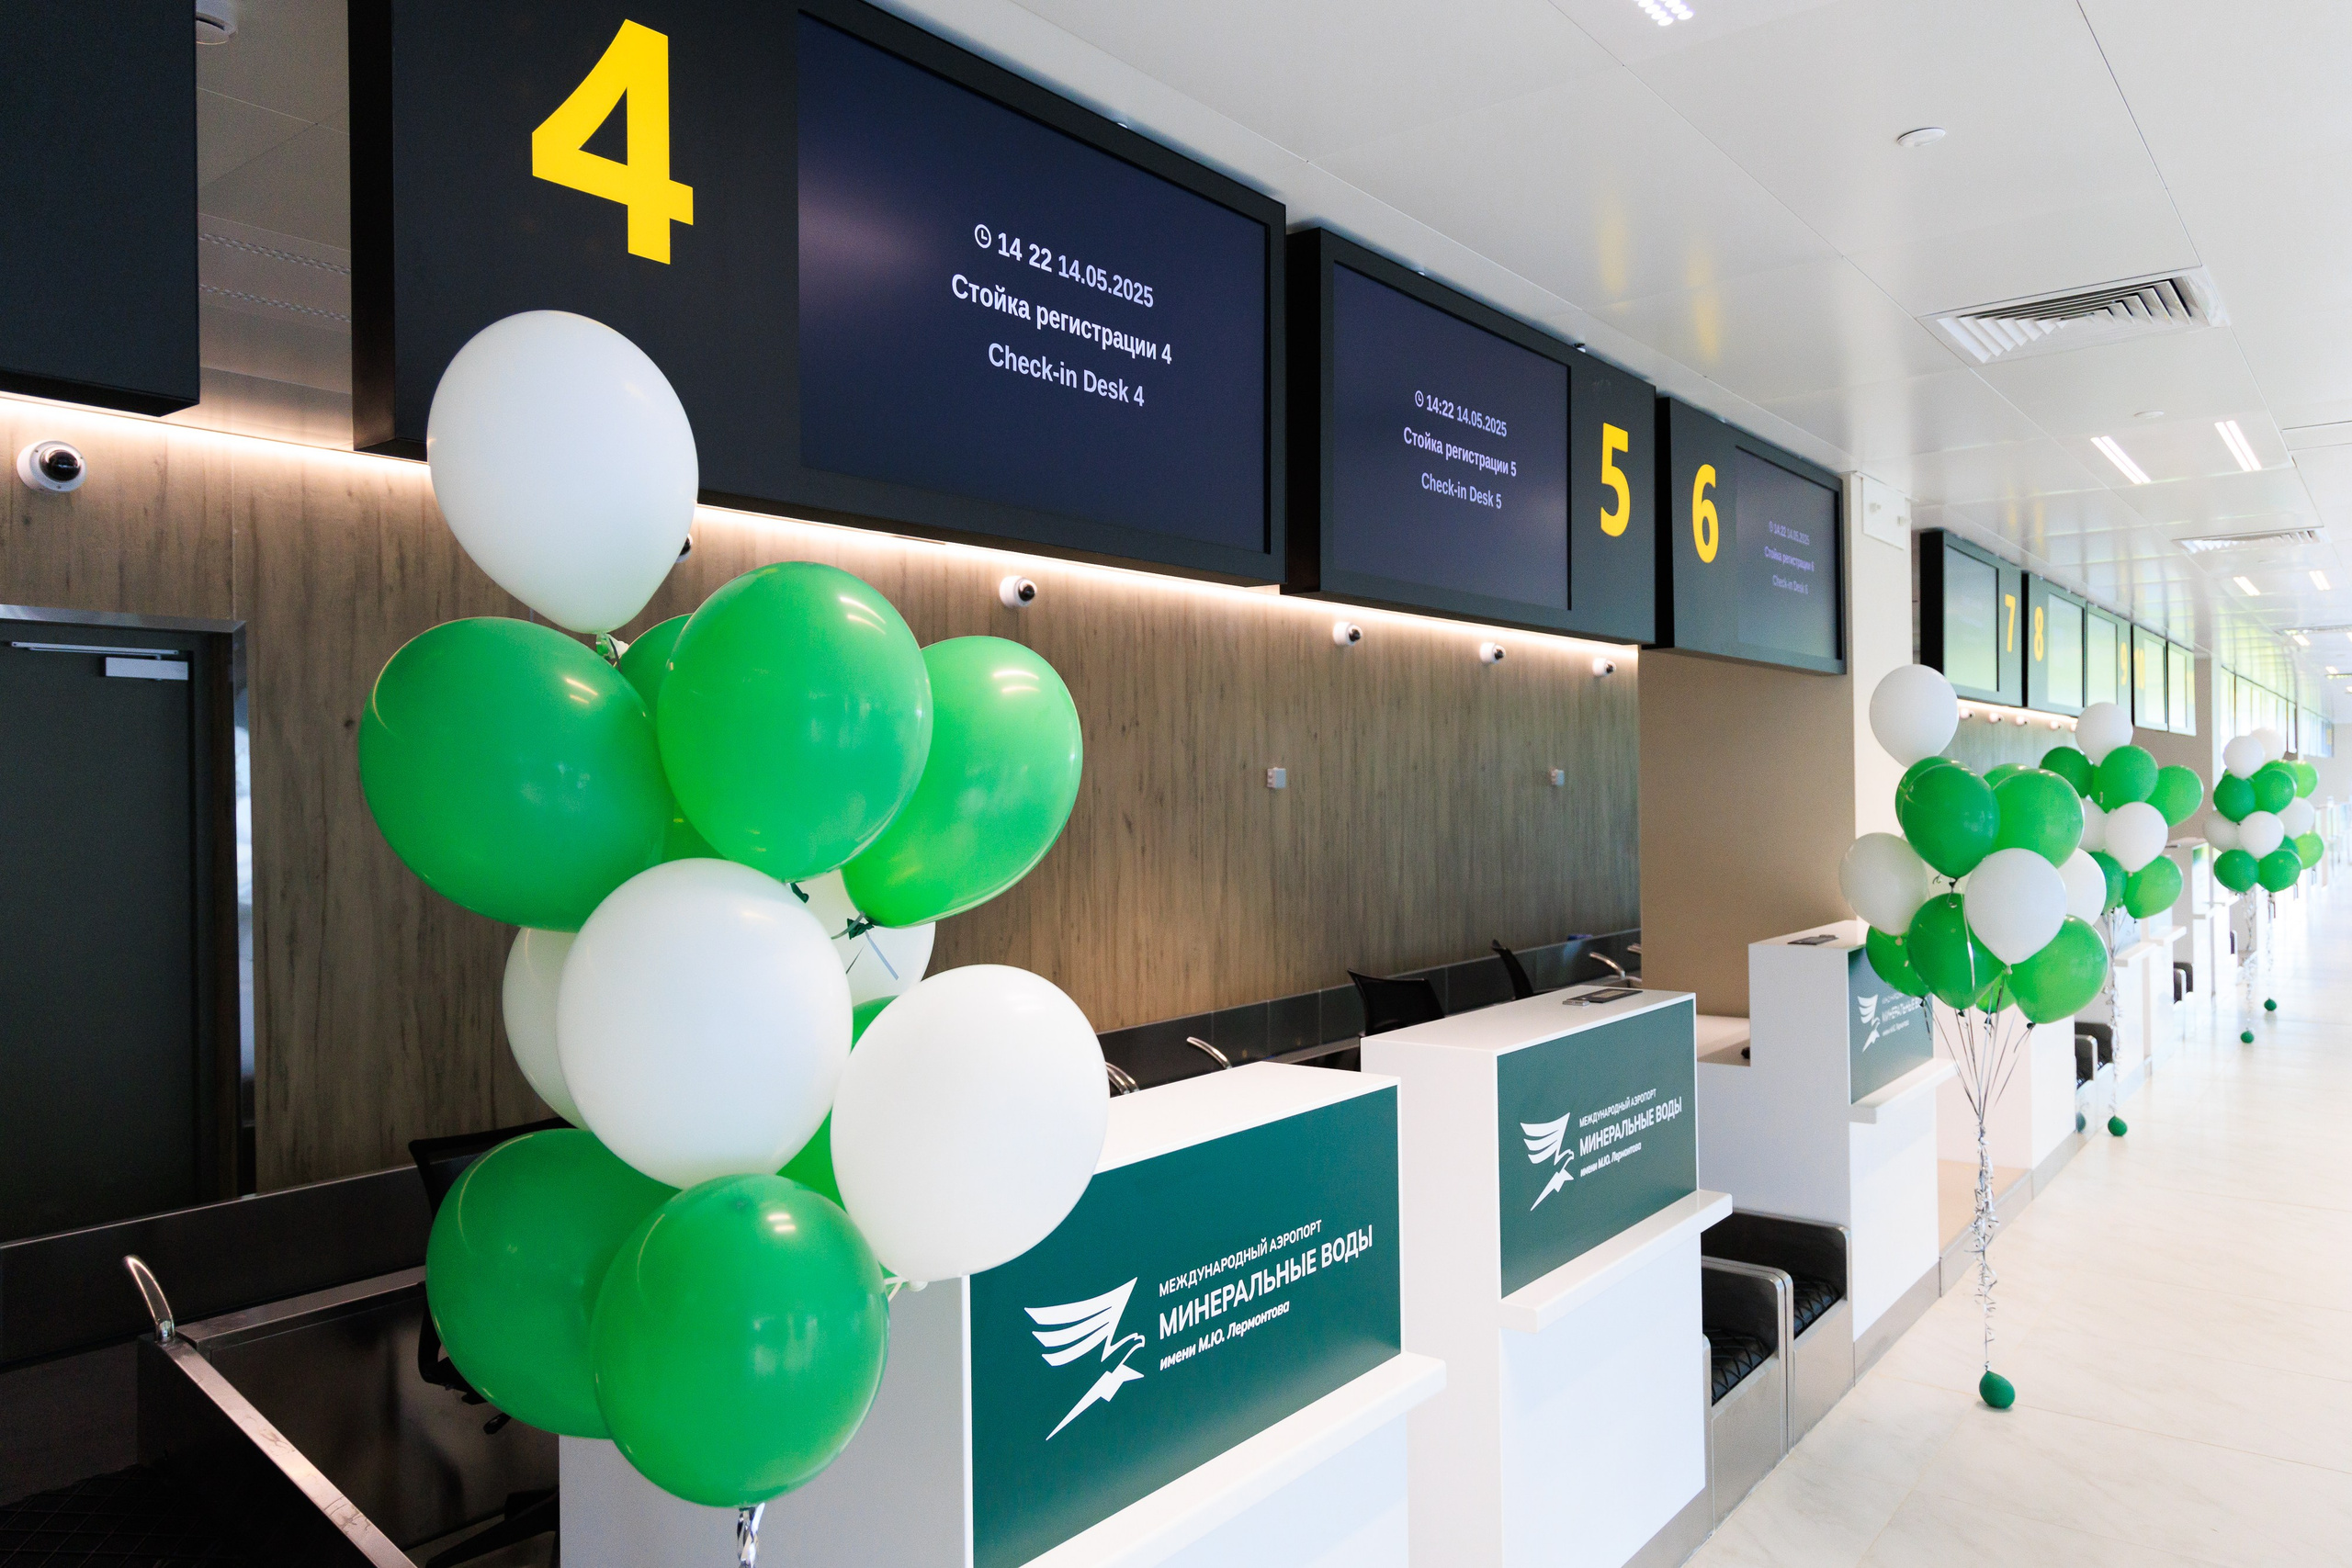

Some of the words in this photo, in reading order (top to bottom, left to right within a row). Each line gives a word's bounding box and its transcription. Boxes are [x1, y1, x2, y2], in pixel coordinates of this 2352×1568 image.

[532, 18, 694, 265] 4
[998, 232, 1023, 262] 14
[1028, 243, 1053, 273] 22
[1058, 254, 1154, 308] 14.05.2025
[951, 274, 1031, 321] Стойка
[1036, 304, 1157, 359] регистрации
[1161, 344, 1172, 365] 4
[988, 343, 1078, 389] Check-in
[1083, 369, 1129, 403] Desk
[1133, 386, 1145, 407] 4
[1426, 394, 1454, 419] 14:22
[1456, 405, 1508, 437] 14.05.2025
[1403, 426, 1443, 455] Стойка
[1445, 443, 1509, 475] регистрации
[1510, 461, 1517, 477] 5
[1600, 423, 1631, 536] 5
[1421, 472, 1467, 500] Check-in
[1469, 485, 1494, 507] Desk
[1496, 493, 1502, 509] 5
[1692, 464, 1719, 564] 6
[2005, 593, 2016, 653] 7
[2033, 606, 2044, 661] 8
[2120, 641, 2128, 686] 9
[1579, 1097, 1630, 1128] МЕЖДУНАРОДНЫЙ
[1630, 1089, 1657, 1106] АЭРОПОРТ
[1579, 1108, 1655, 1156] МИНЕРАЛЬНЫЕ
[1656, 1096, 1682, 1122] ВОДЫ
[1580, 1162, 1598, 1177] имени
[1159, 1237, 1268, 1297] МЕЖДУНАРОДНЫЙ
[1269, 1219, 1322, 1253] АЭРОПОРТ
[1159, 1248, 1317, 1340] МИНЕРАЛЬНЫЕ
[1321, 1224, 1373, 1269] ВОДЫ
[1159, 1343, 1196, 1371] имени
[1198, 1328, 1225, 1353] М.Ю.
[1227, 1301, 1290, 1339] Лермонтова
